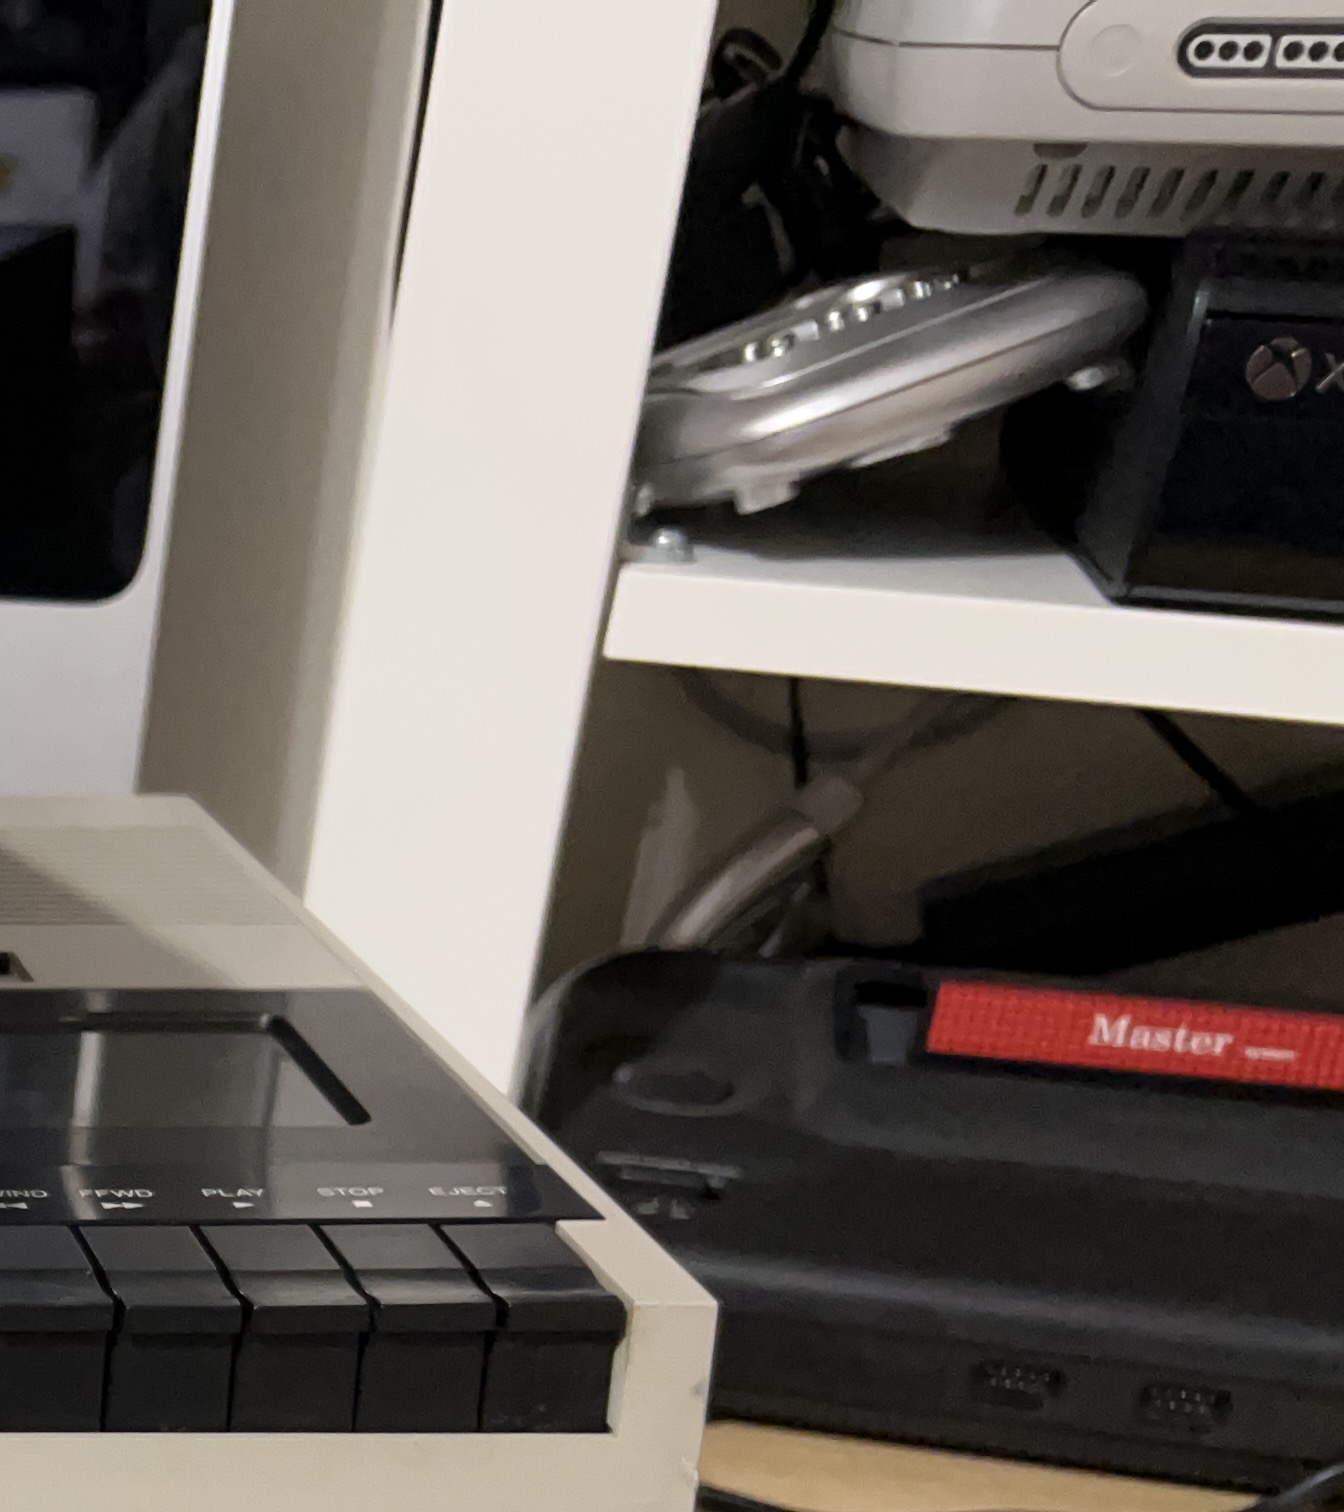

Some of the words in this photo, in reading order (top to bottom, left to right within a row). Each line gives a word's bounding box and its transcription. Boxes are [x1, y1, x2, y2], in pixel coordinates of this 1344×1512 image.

[1088, 1013, 1234, 1056] Master
[78, 1187, 154, 1199] FFWD
[200, 1187, 265, 1198] PLAY
[316, 1186, 384, 1197] STOP
[428, 1185, 508, 1196] EJECT
